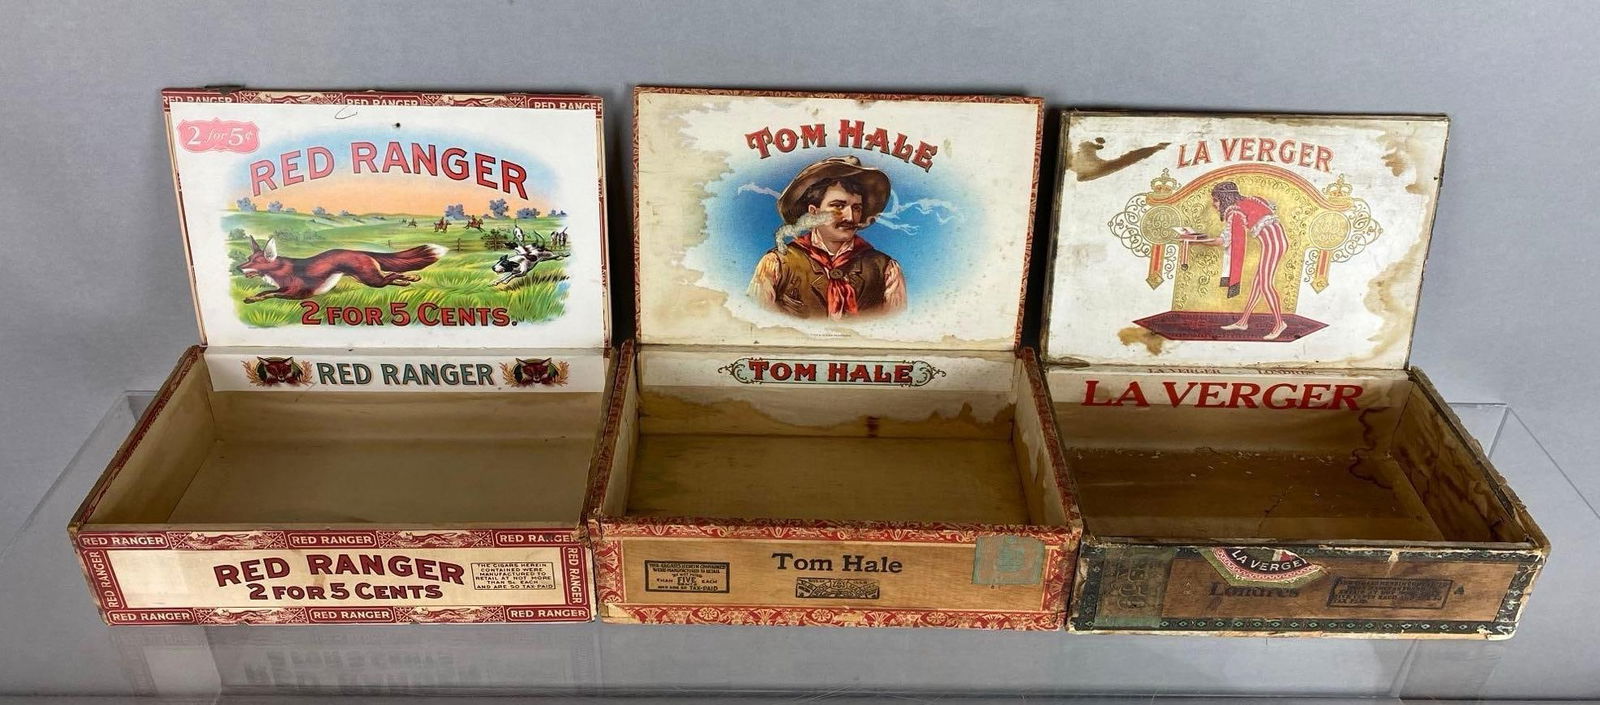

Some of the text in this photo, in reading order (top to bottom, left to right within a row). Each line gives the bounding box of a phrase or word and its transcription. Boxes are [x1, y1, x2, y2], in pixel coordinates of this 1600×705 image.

[163, 96, 183, 104] RED
[534, 101, 556, 109] RED
[186, 125, 202, 145] 2
[204, 128, 227, 143] for
[745, 119, 938, 172] TOM HALE
[1176, 137, 1335, 173] LA VERGER
[250, 141, 528, 200] RED RANGER
[300, 301, 322, 326] 2
[326, 306, 384, 326] FOR
[390, 302, 410, 326] 5
[315, 362, 495, 386] RED RANGER
[748, 360, 914, 383] TOM HALE
[1081, 380, 1364, 411] LA VERGER
[82, 537, 164, 545] RED RANGER
[292, 535, 373, 544] RED RANGER
[528, 534, 577, 542] RAGE
[213, 554, 465, 587] RED RANGER
[772, 552, 903, 574] Tom Hale
[1231, 549, 1308, 571] LA VERGE
[89, 551, 119, 607] RED RANGER
[568, 547, 582, 604] RED RANGER
[677, 576, 696, 584] FIVE
[246, 582, 443, 600] 2 FOR 5 CENTS
[112, 612, 193, 621] RED RANGER
[313, 611, 390, 619] RED RANGER
[538, 609, 586, 617] RANGER
